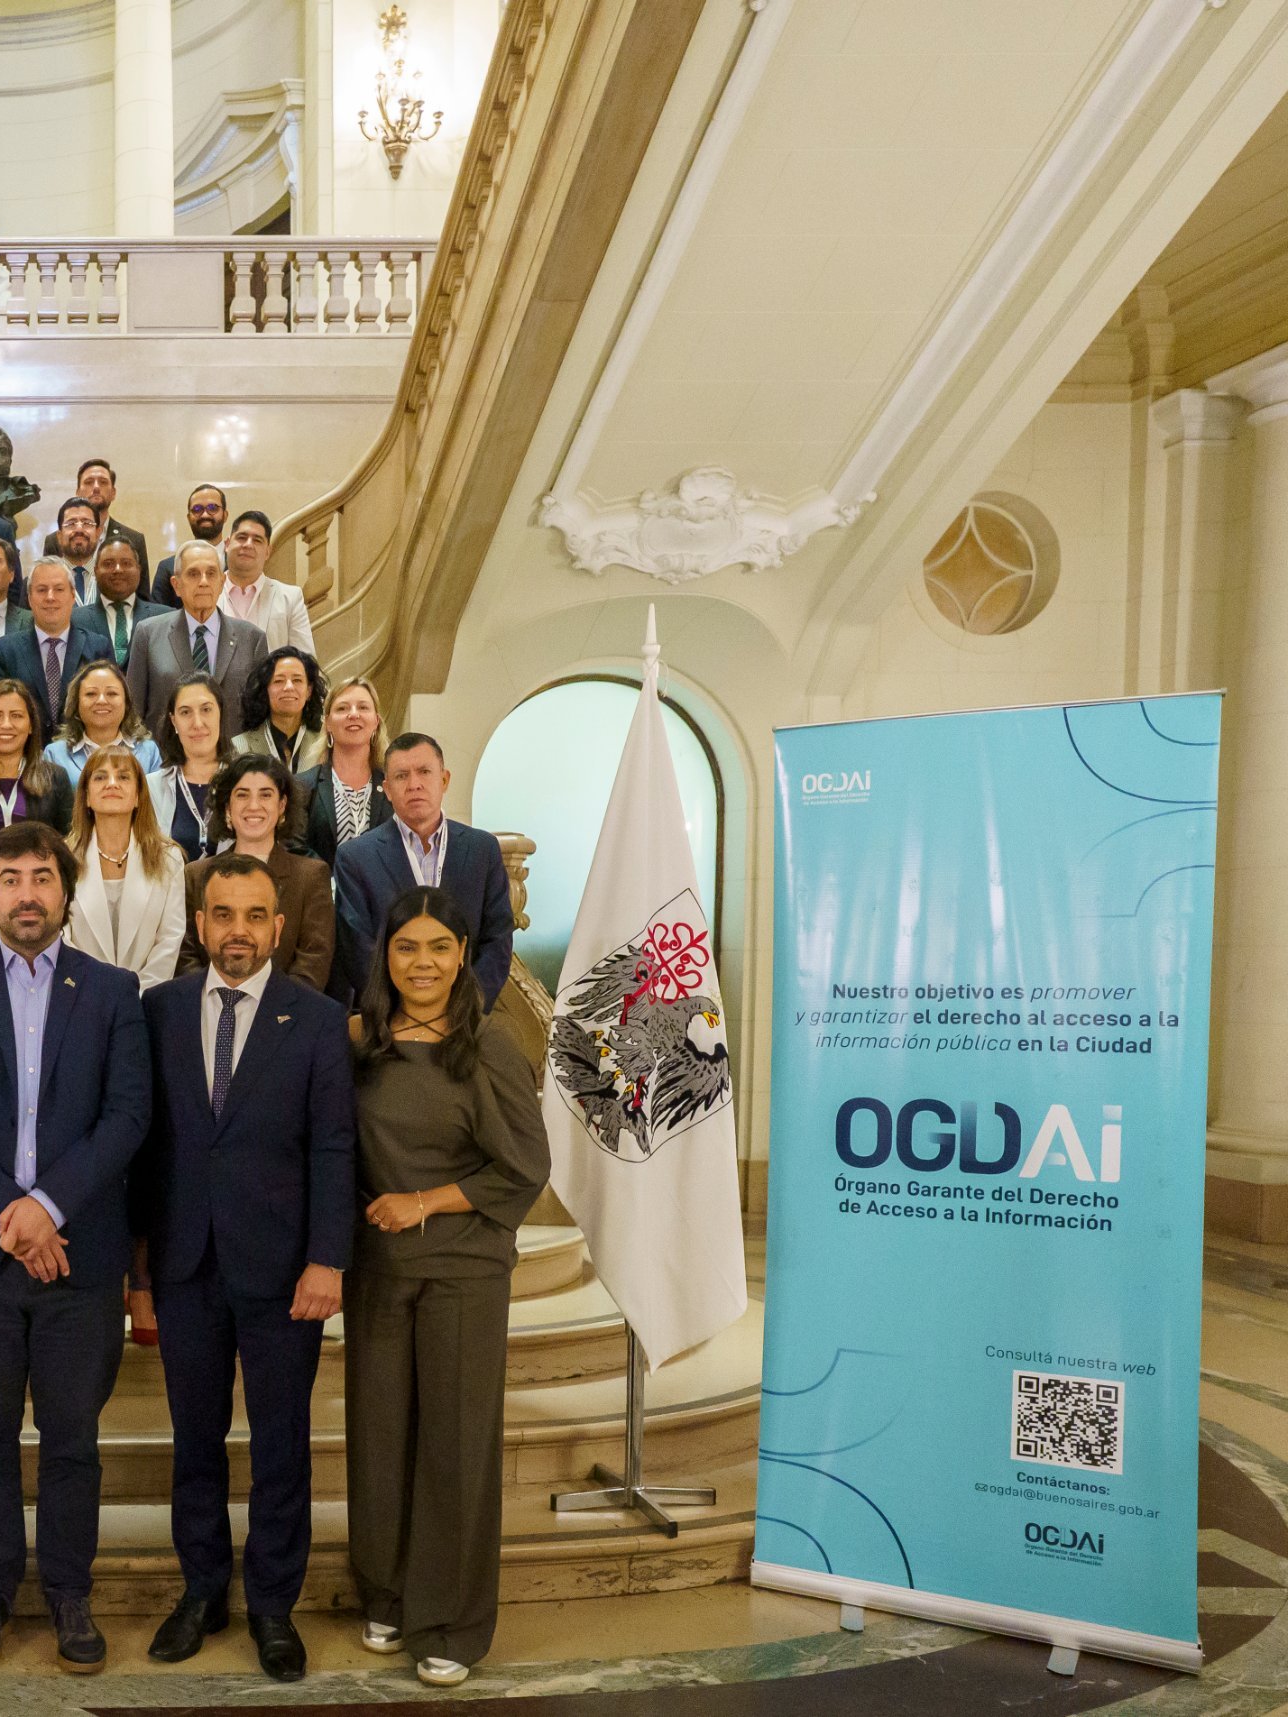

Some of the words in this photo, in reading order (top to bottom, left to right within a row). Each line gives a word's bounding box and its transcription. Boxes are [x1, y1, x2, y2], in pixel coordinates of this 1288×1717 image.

[832, 983, 909, 1000] Nuestro
[914, 983, 994, 1002] objetivo
[1000, 987, 1025, 1000] es
[1030, 986, 1137, 1003] promover
[794, 1010, 806, 1026] y
[810, 1009, 909, 1026] garantizar
[913, 1009, 931, 1024] el
[937, 1009, 1021, 1026] derecho
[1027, 1010, 1047, 1026] al
[1052, 1012, 1132, 1027] acceso
[1138, 1014, 1151, 1027] a
[1158, 1010, 1179, 1027] la
[815, 1032, 931, 1050] información
[935, 1034, 1012, 1052] pública
[1017, 1038, 1043, 1052] en
[1049, 1036, 1069, 1052] la
[1076, 1036, 1152, 1054] Ciudad
[834, 1172, 901, 1196] Órgano
[907, 1180, 985, 1200] Garante
[991, 1186, 1024, 1203] del
[1029, 1188, 1119, 1209] Derecho
[839, 1198, 862, 1213] de
[866, 1200, 938, 1219] Acceso
[943, 1207, 955, 1220] a
[960, 1205, 979, 1222] la
[985, 1207, 1112, 1232] Información
[985, 1345, 1053, 1365] Consultá
[1057, 1355, 1118, 1371] nuestra
[1122, 1362, 1157, 1376] web
[1016, 1471, 1111, 1496] Contáctanos:
